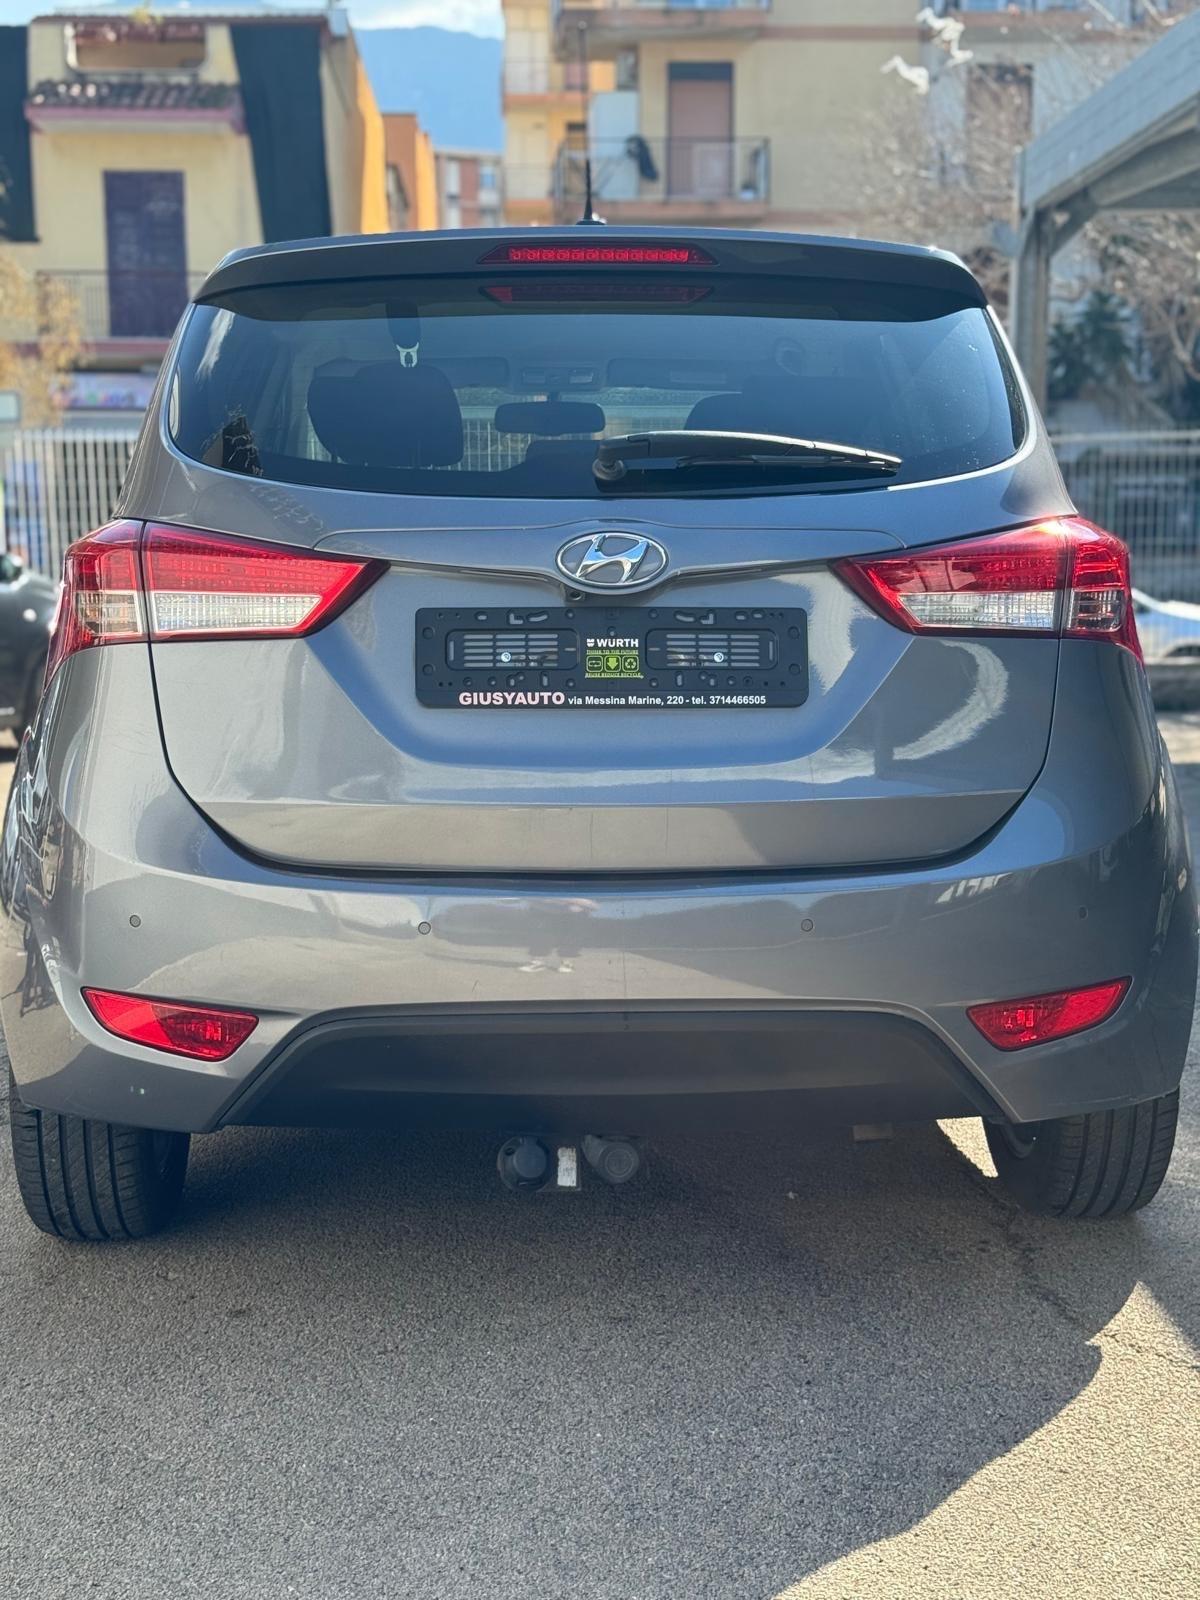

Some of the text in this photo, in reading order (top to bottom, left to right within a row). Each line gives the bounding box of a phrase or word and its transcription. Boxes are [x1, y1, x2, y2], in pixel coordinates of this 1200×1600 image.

[458, 691, 566, 706] GIUSYAUTO
[567, 694, 583, 705] via
[585, 694, 626, 705] Messina
[628, 694, 665, 707] Marine,
[666, 695, 685, 705] 220
[691, 695, 707, 705] tel.
[709, 695, 767, 705] 3714466505
